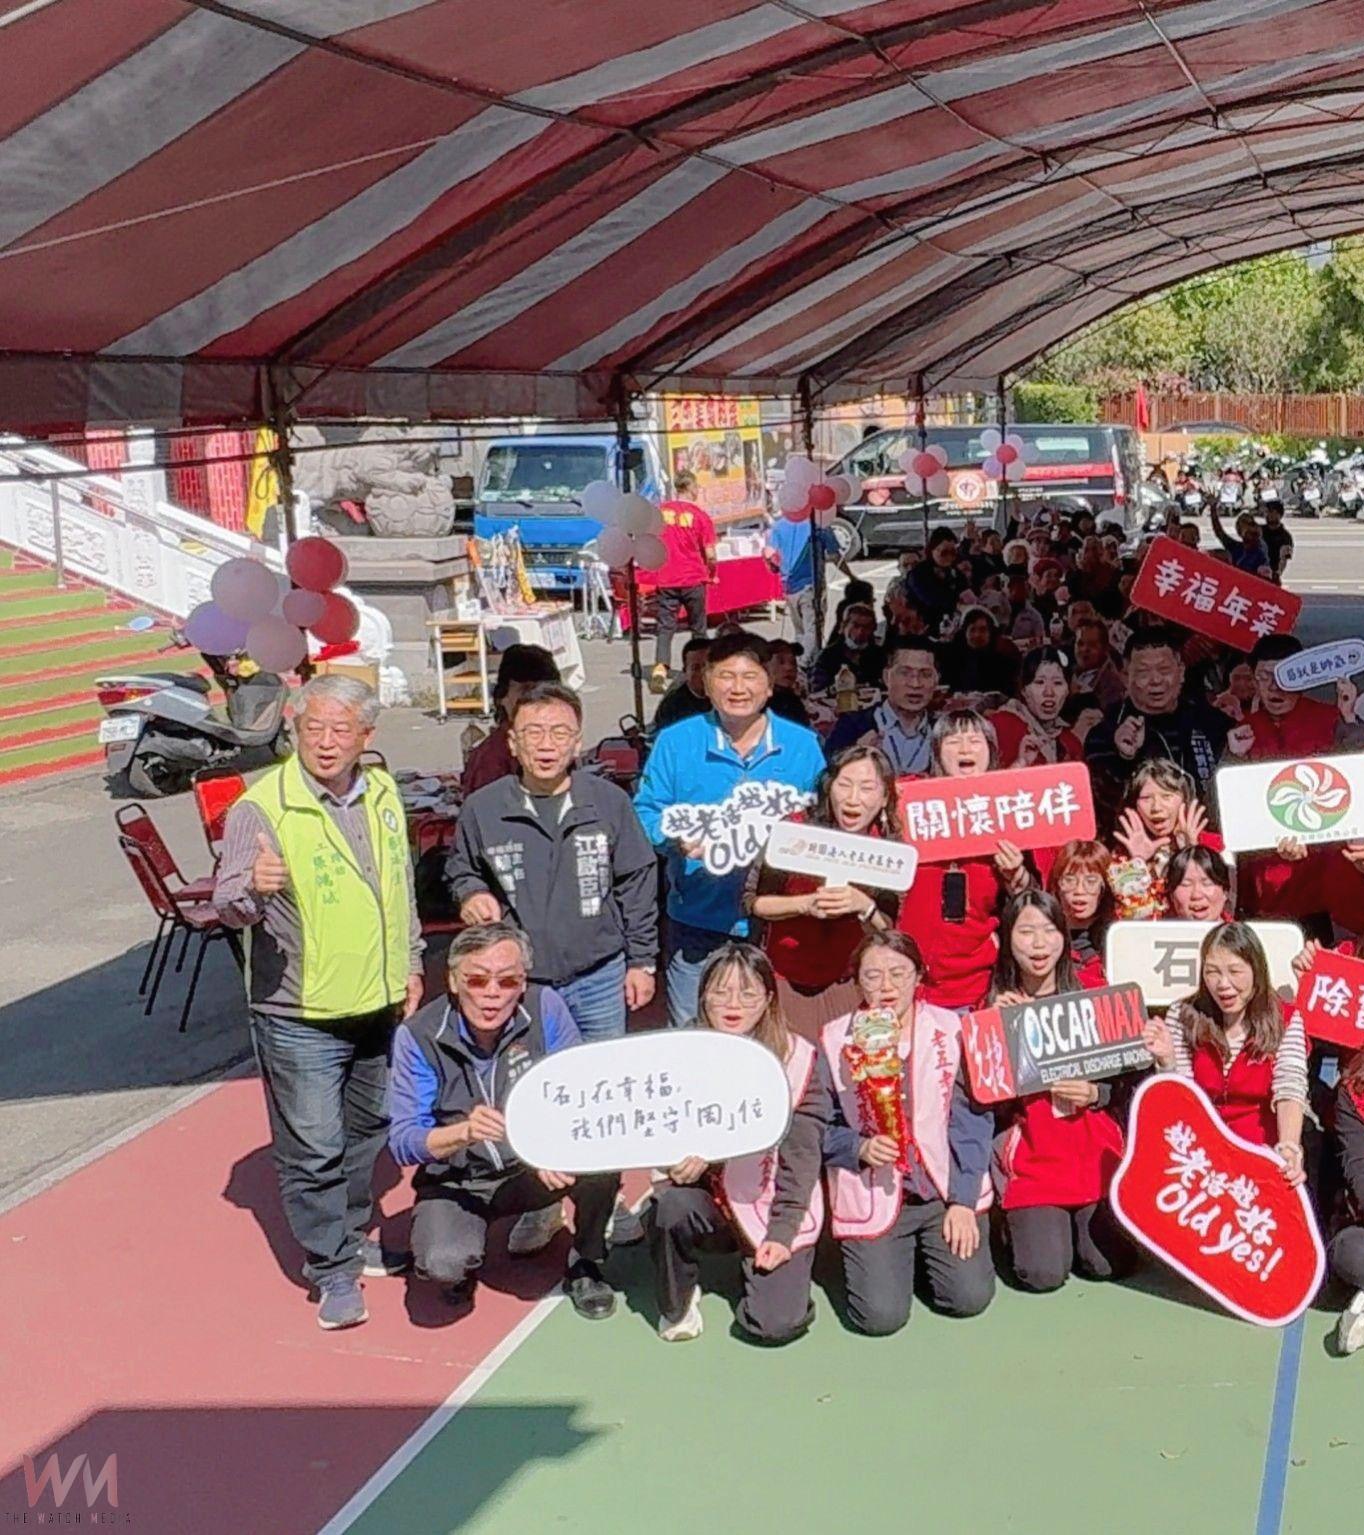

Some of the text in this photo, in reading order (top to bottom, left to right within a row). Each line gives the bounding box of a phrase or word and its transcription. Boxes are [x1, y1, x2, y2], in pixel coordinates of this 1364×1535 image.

[1154, 557, 1286, 638] 幸福年菜
[709, 824, 765, 870] Old
[906, 781, 1081, 842] 關懷陪伴
[1023, 987, 1145, 1060] OSCARMAX
[1155, 1181, 1285, 1283] Old yes!
